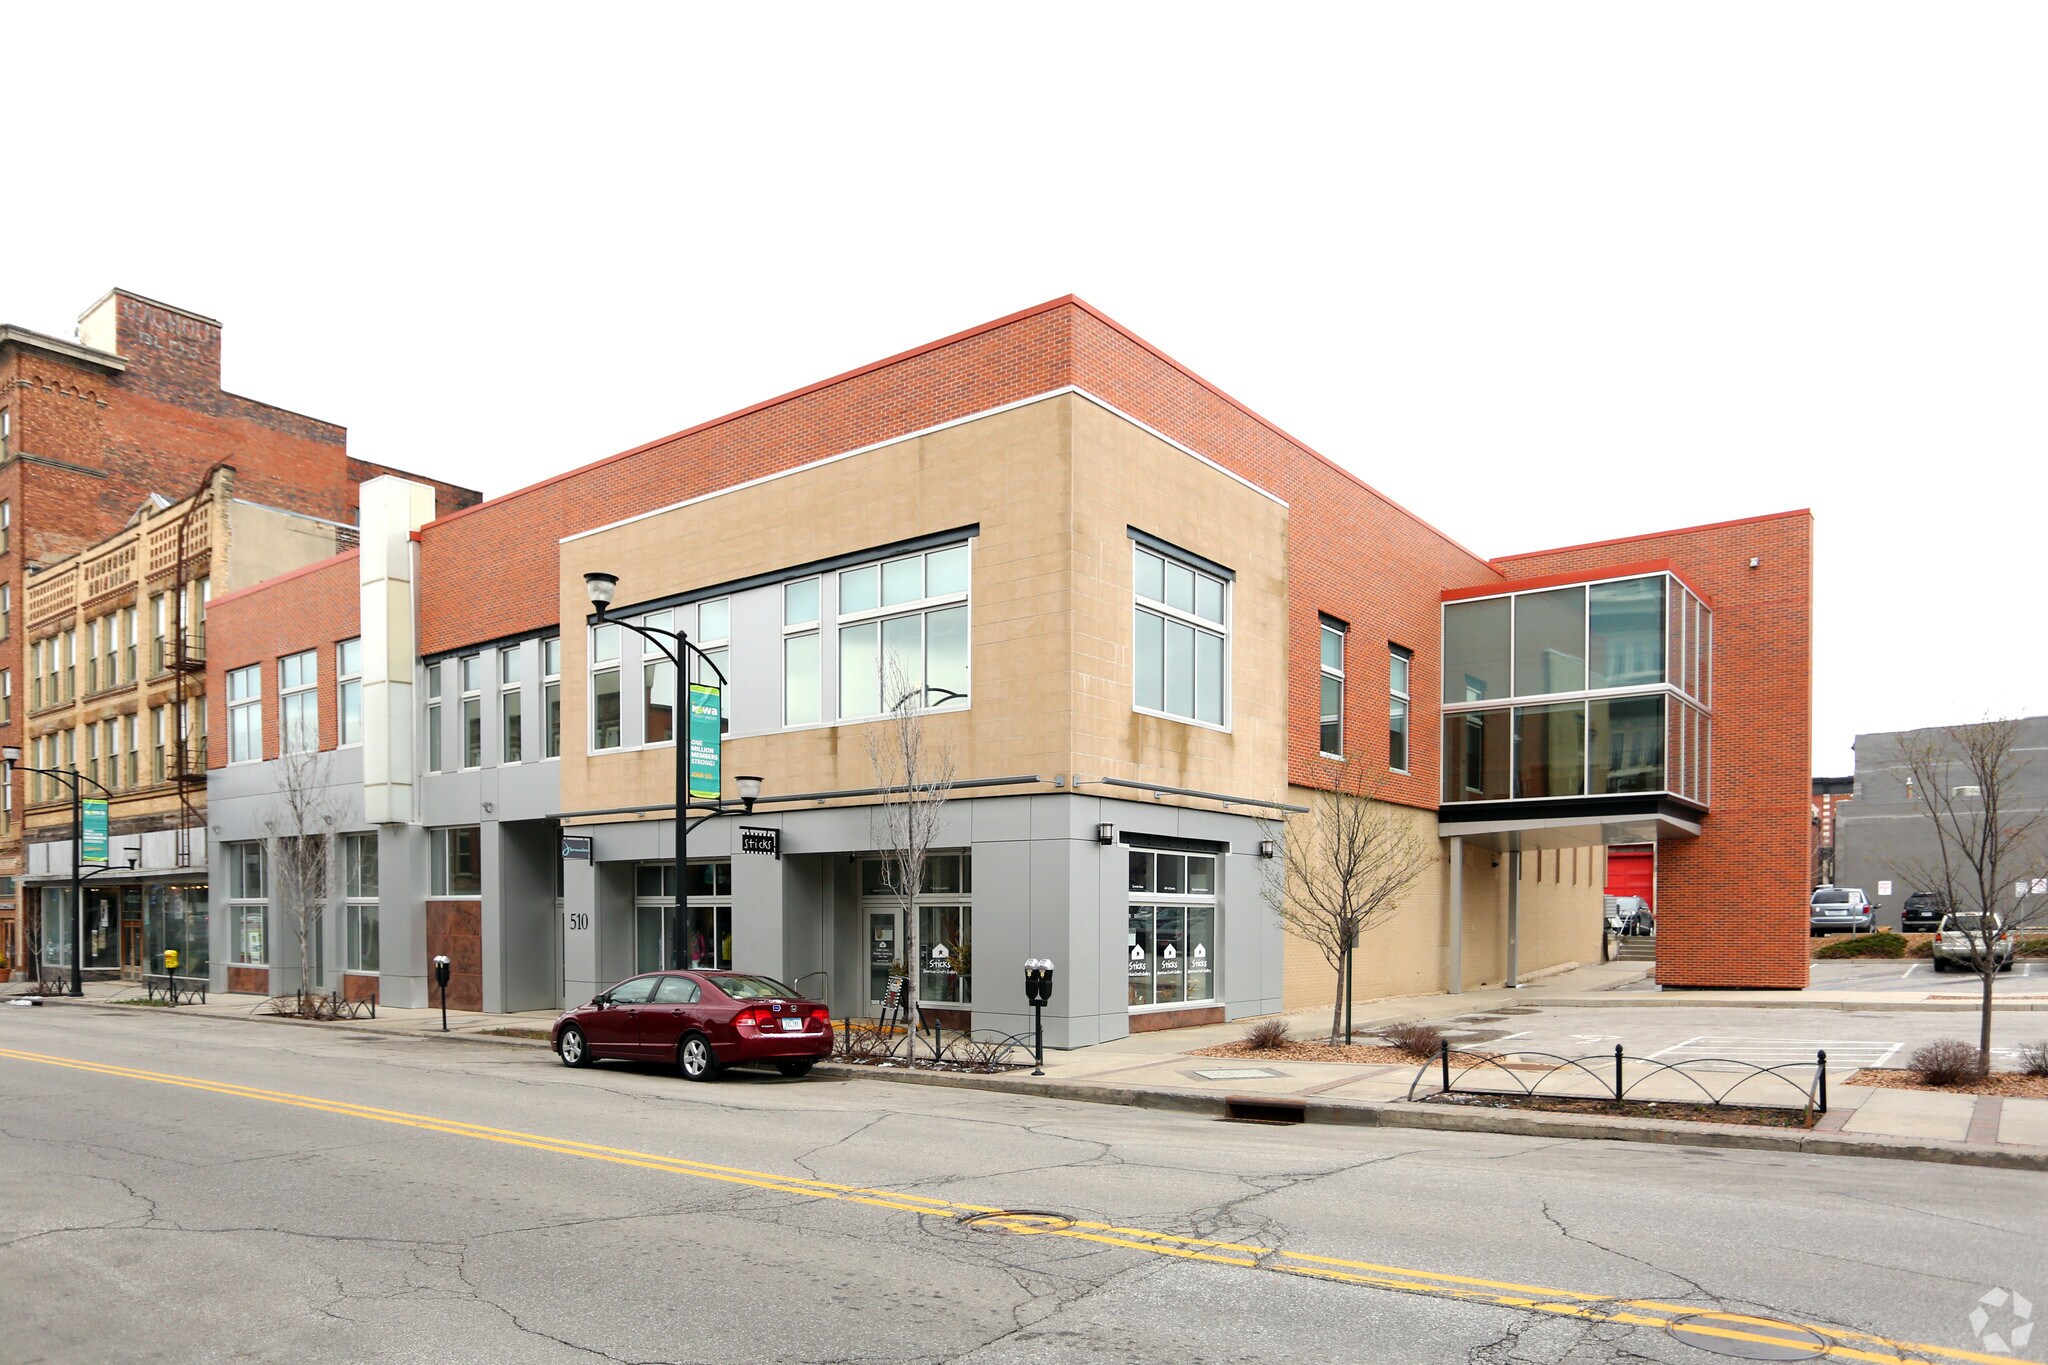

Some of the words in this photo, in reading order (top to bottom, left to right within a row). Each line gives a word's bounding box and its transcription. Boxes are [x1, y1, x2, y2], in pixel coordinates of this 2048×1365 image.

[691, 739, 703, 747] ONE
[691, 745, 714, 754] MILLION
[691, 752, 718, 760] MEMBERS
[691, 759, 715, 767] STRONG!
[744, 838, 772, 850] Sticks
[570, 912, 589, 930] 510
[929, 959, 951, 969] Sticks
[1128, 961, 1146, 971] Sticks
[1161, 960, 1178, 969] Sticks
[1192, 959, 1208, 968] Sticks
